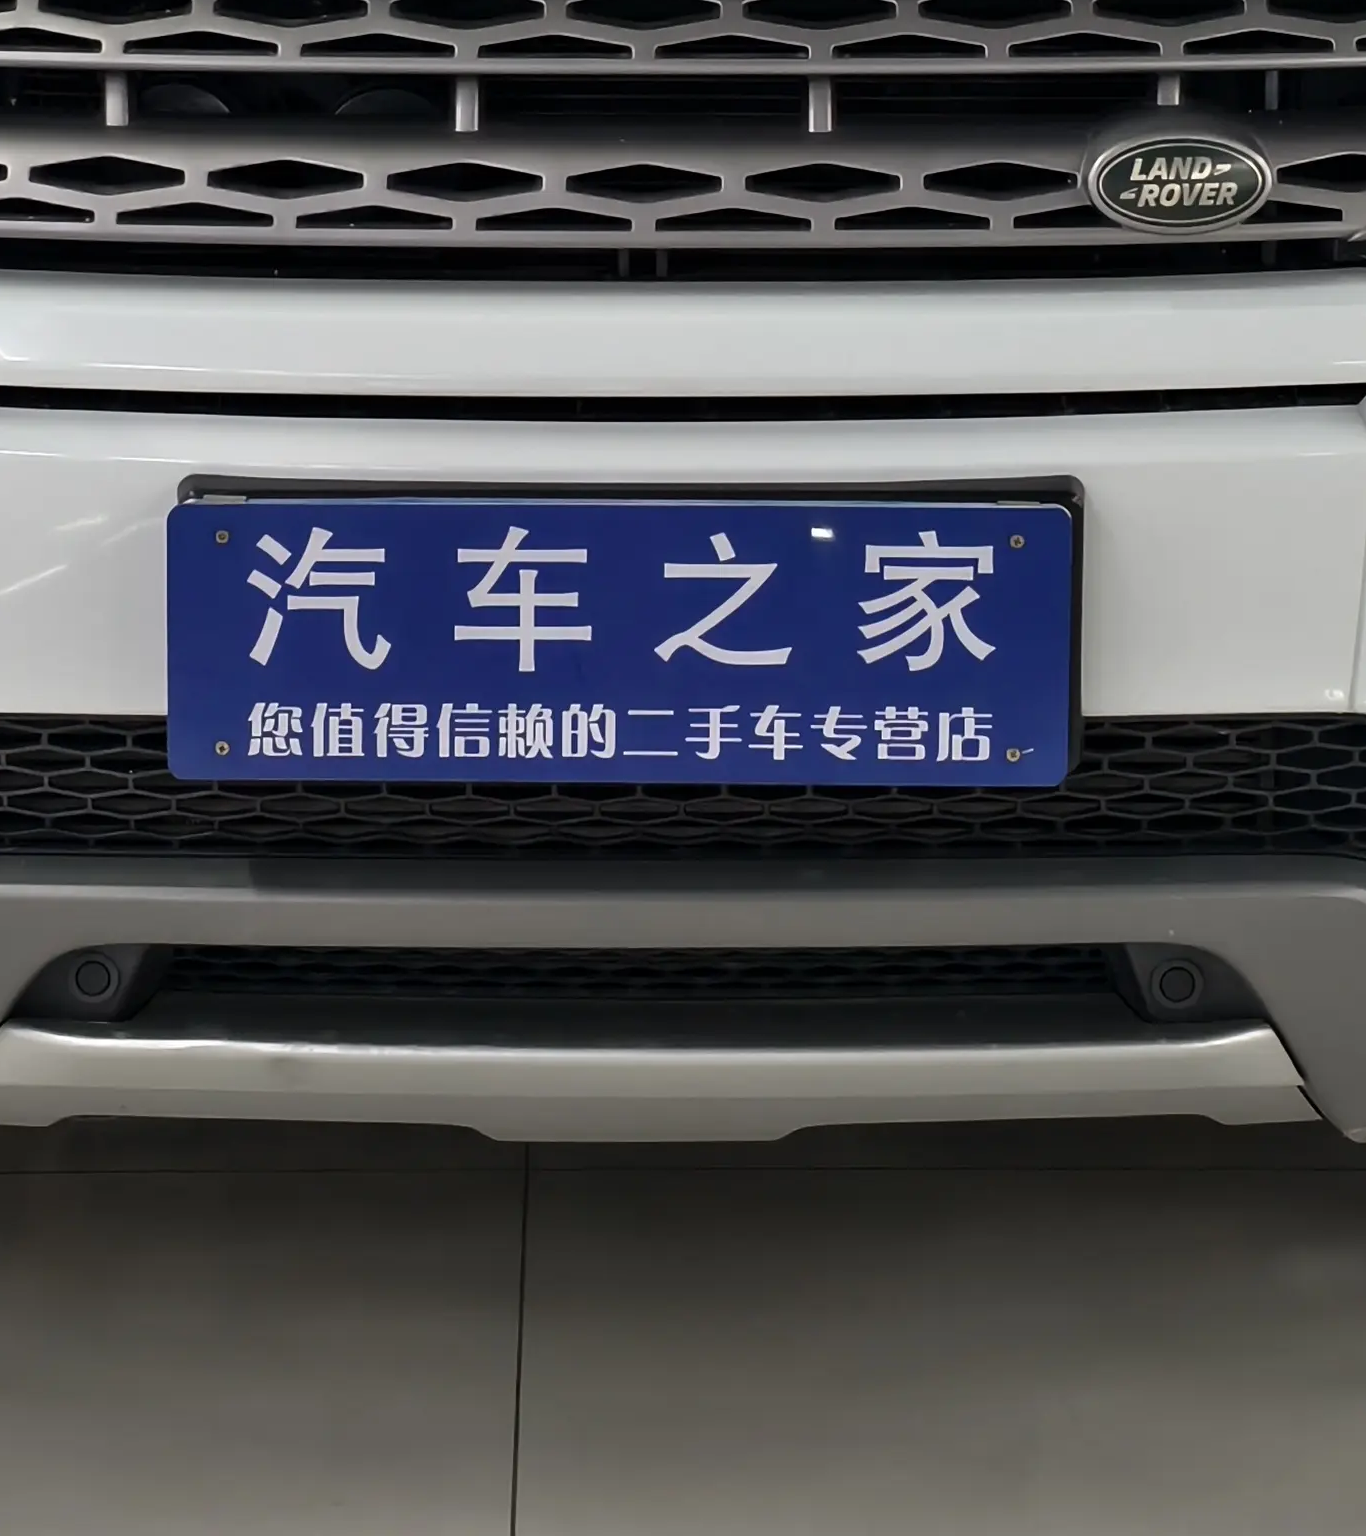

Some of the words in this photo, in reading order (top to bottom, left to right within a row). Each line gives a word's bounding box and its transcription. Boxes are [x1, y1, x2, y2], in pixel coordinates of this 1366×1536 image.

[1129, 156, 1212, 181] LAND
[1137, 181, 1239, 208] ROVER
[247, 525, 996, 672] 汽车之家
[247, 702, 992, 761] 您值得信赖的二手车专营店
